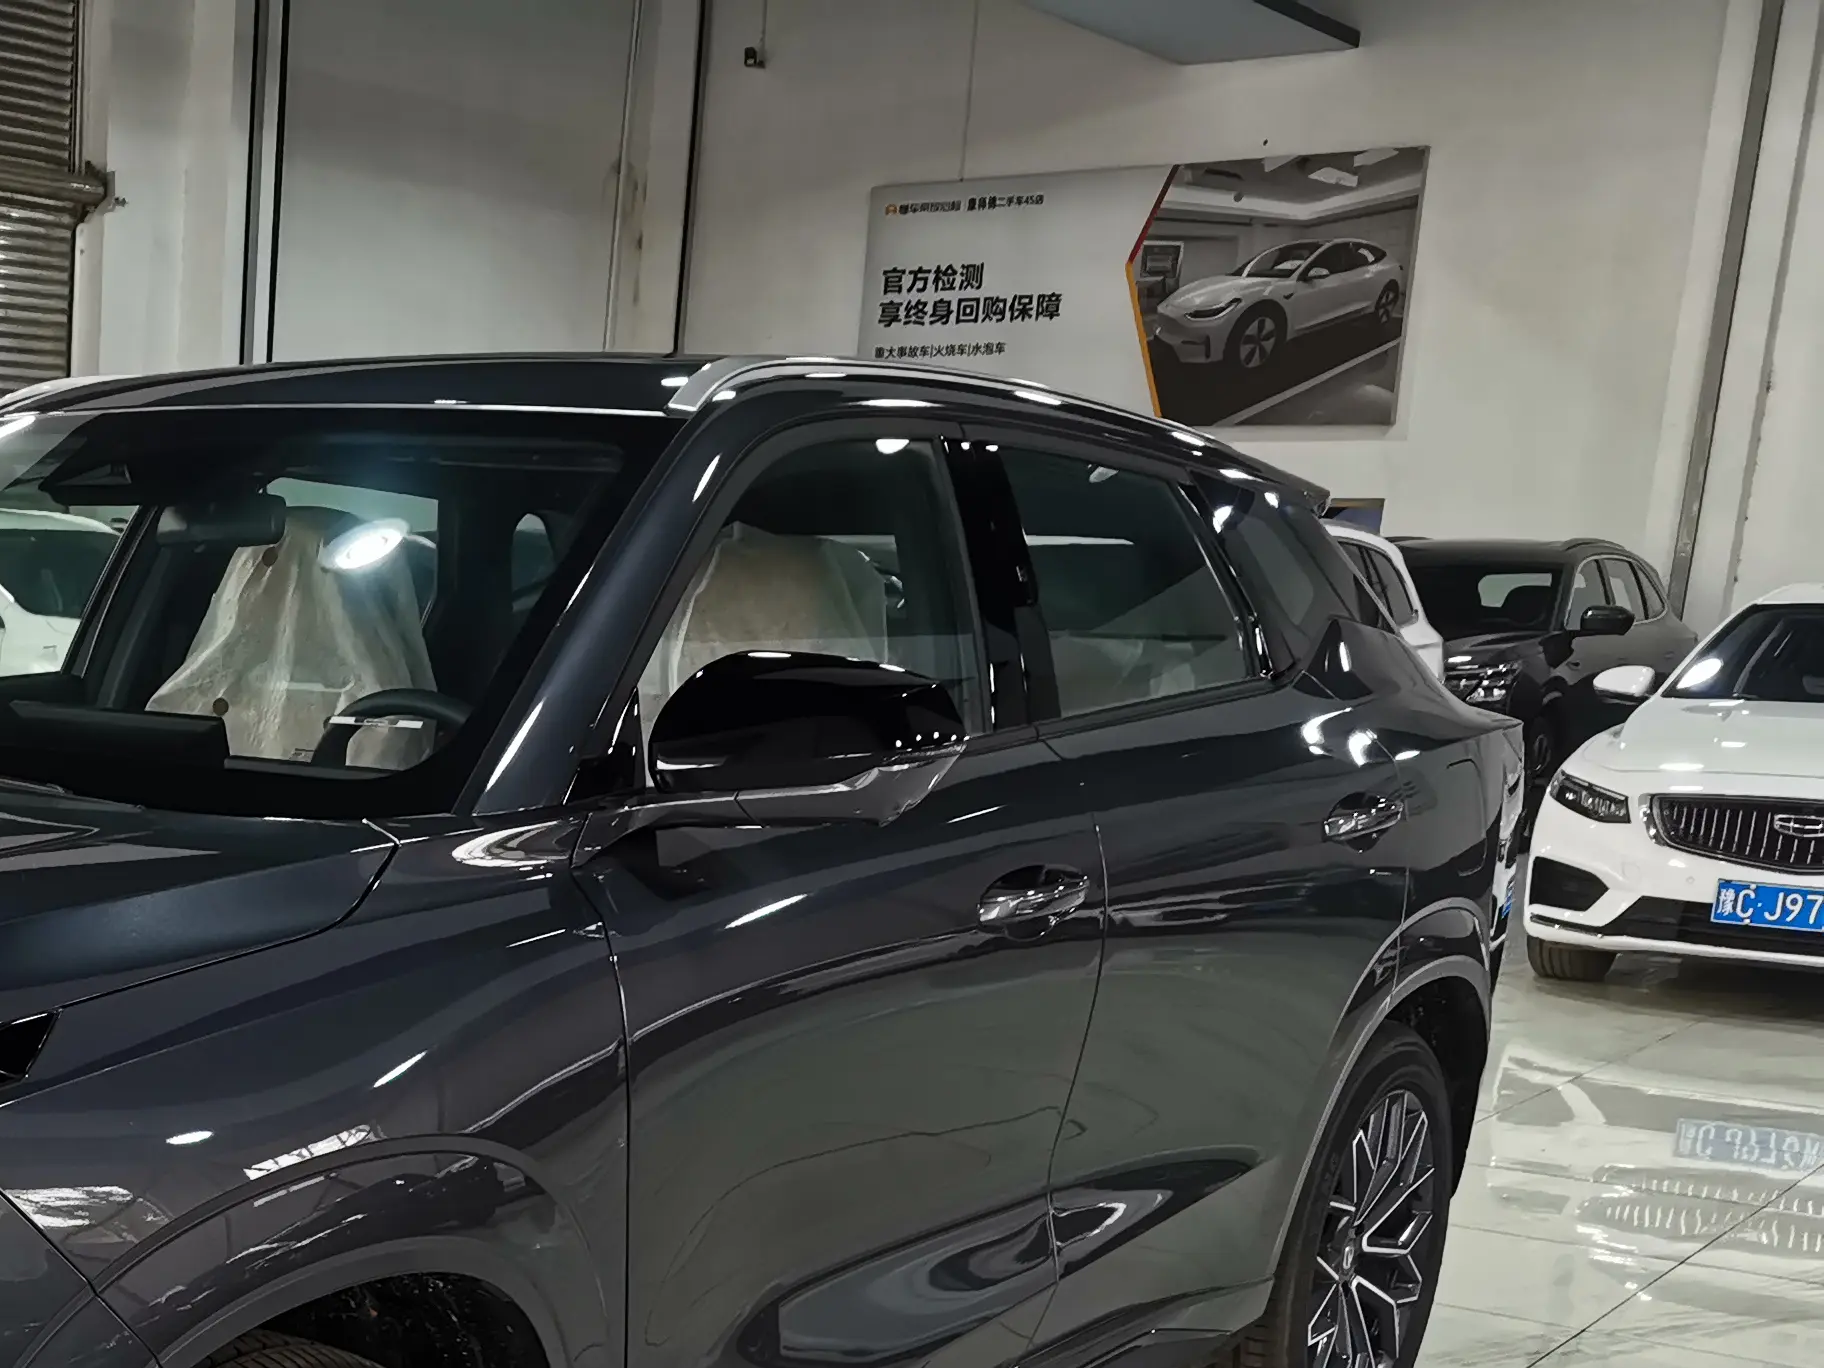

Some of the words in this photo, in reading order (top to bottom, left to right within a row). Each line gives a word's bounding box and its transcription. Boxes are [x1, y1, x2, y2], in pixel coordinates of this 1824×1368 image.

[882, 262, 984, 295] 官方检测
[877, 292, 1062, 328] 享终身回购保障
